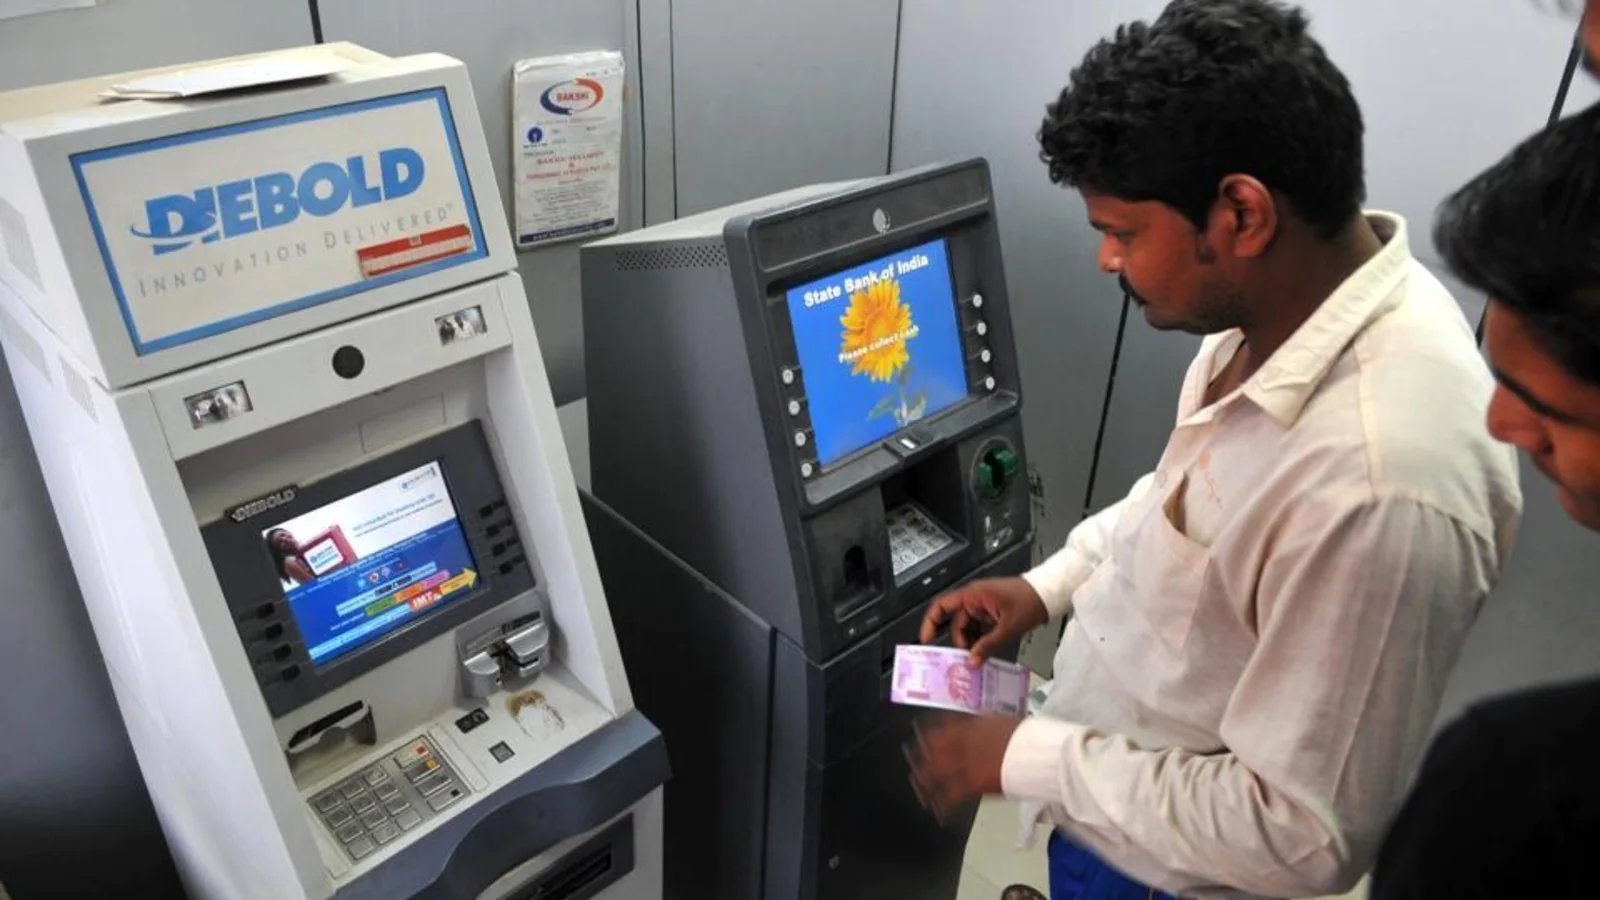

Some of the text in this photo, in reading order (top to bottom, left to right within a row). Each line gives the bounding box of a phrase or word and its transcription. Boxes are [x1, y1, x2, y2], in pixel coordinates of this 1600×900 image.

[555, 91, 590, 103] BAKSHI
[131, 147, 425, 256] DIEBOLD
[138, 240, 308, 298] INNOVATION
[803, 254, 929, 308] State Bank of India
[838, 324, 920, 363] Please collect cash
[230, 487, 296, 523] DIEBOLD
